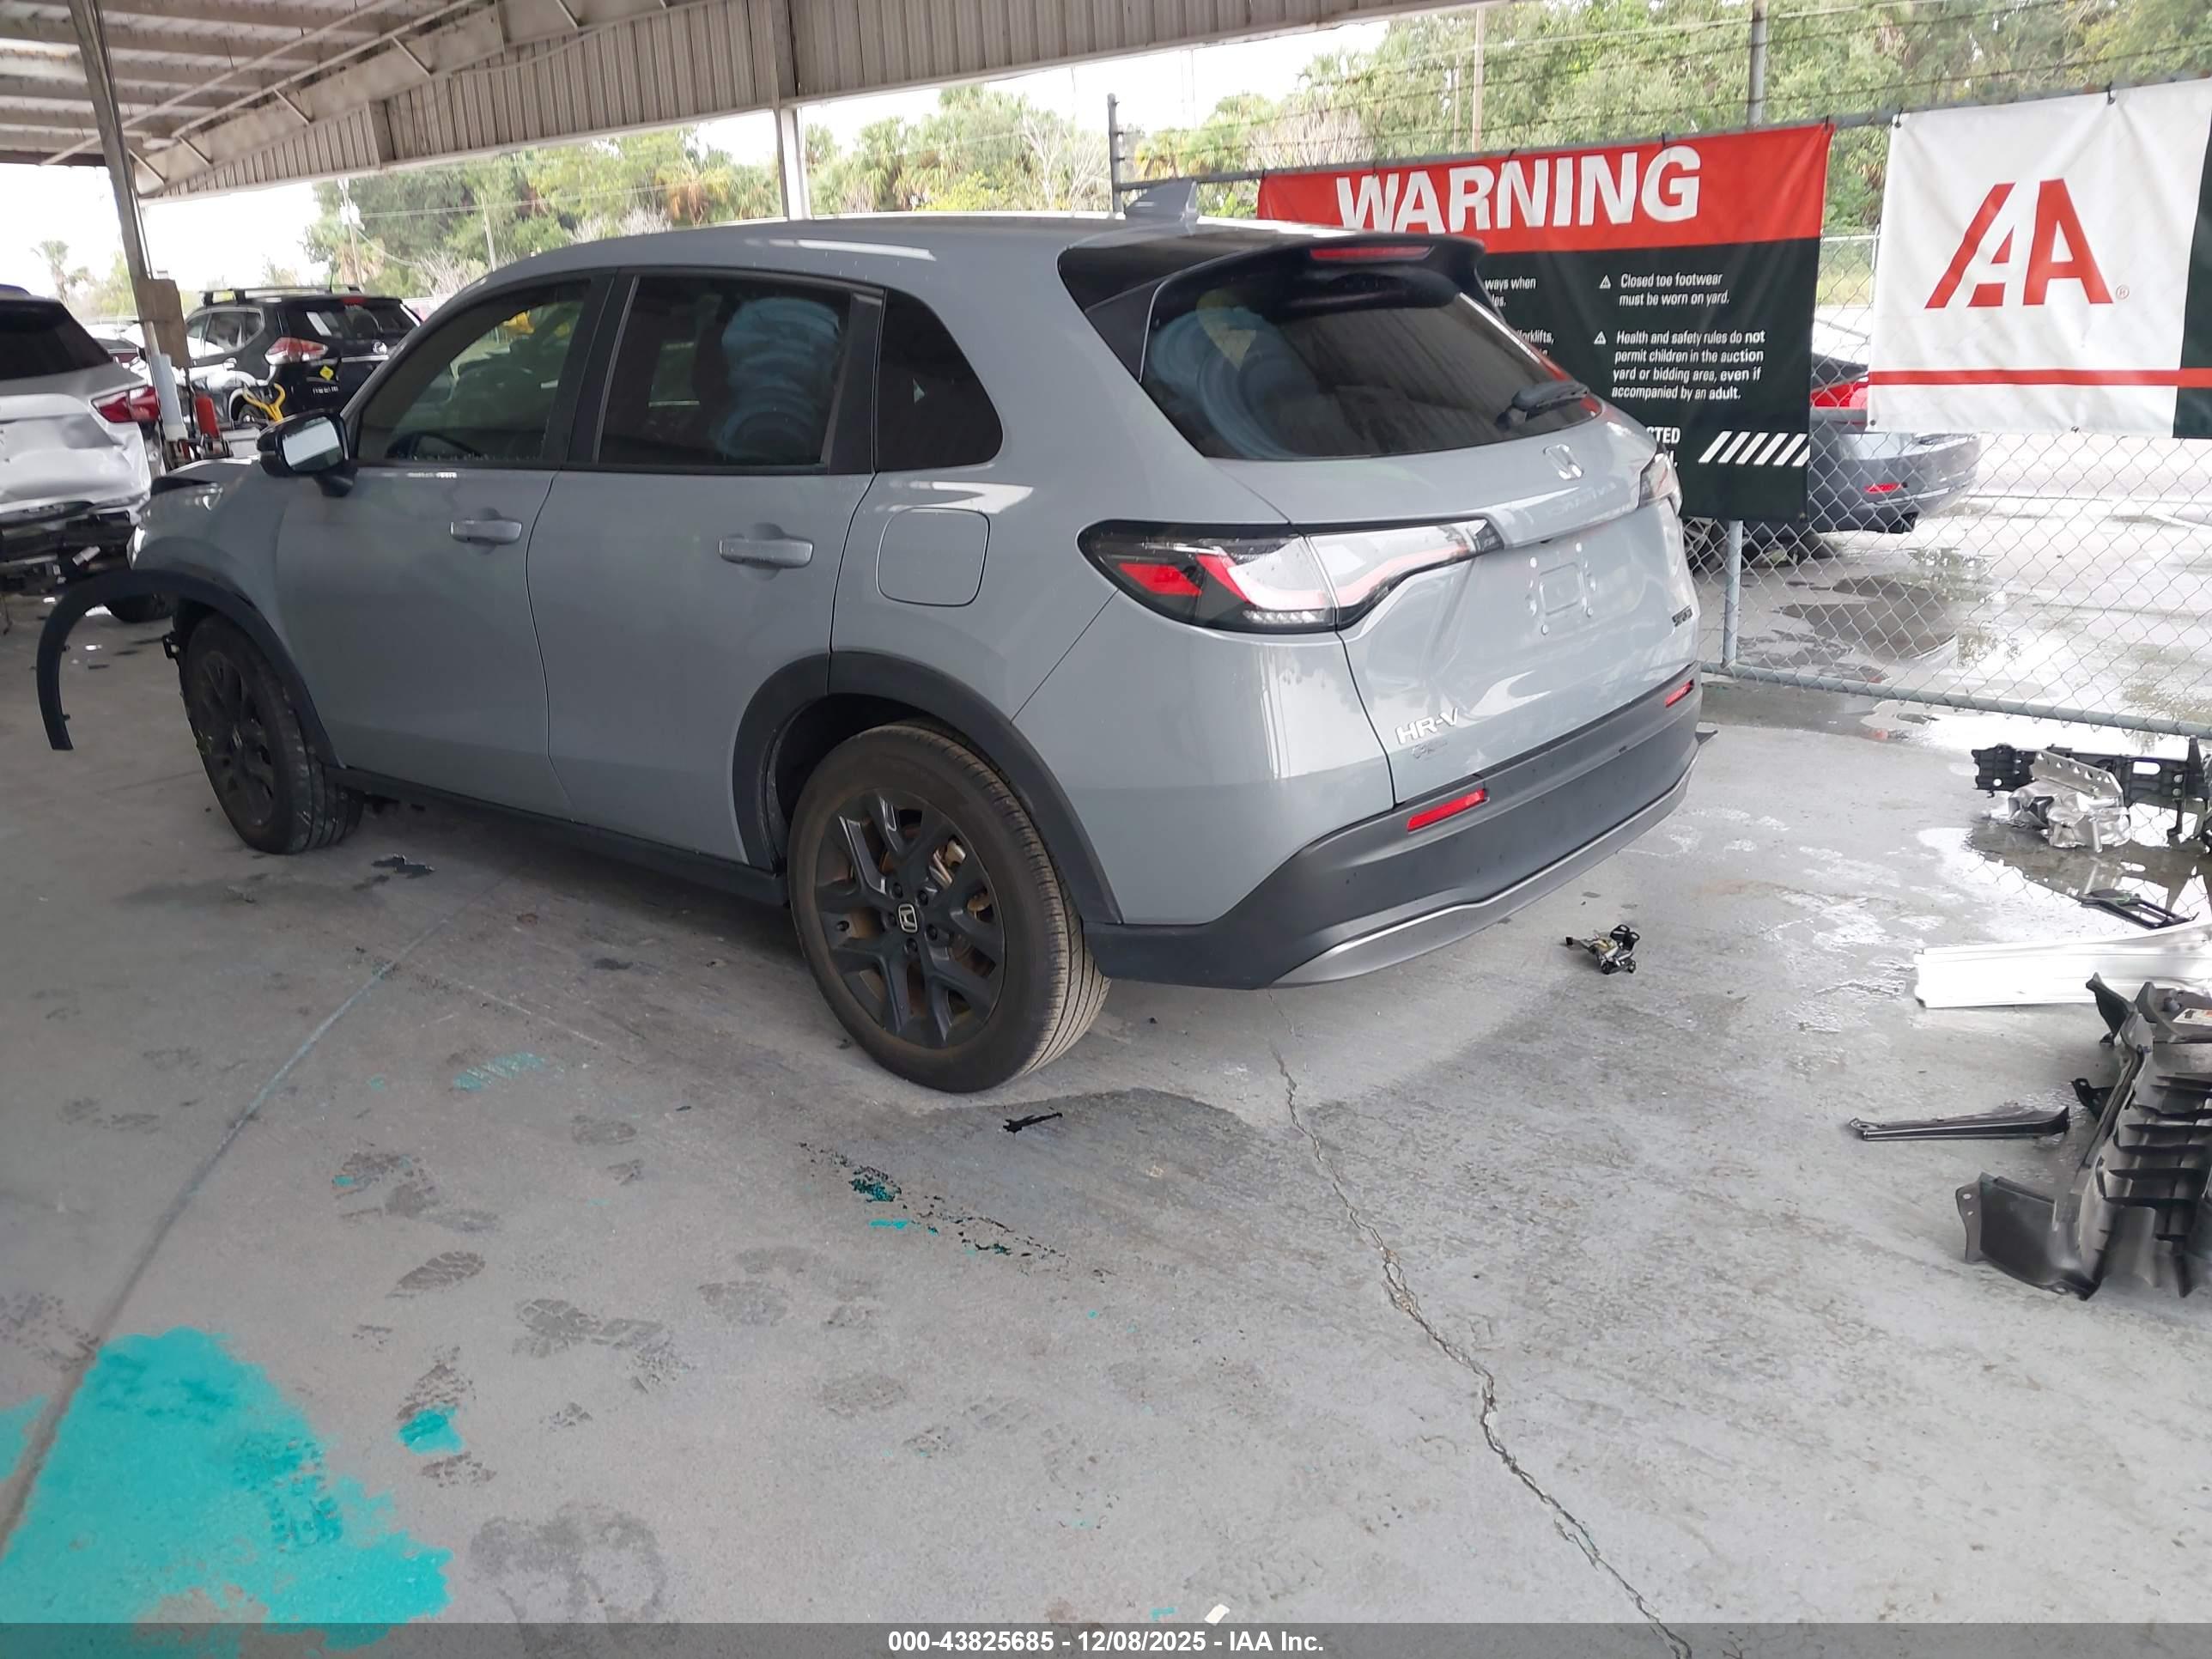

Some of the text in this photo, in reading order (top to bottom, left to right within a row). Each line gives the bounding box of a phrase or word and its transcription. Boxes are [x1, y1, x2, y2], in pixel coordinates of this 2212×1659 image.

[1336, 145, 1701, 234] WARNING
[1511, 276, 1536, 289] when
[1620, 272, 1723, 289] Closed toe footwear
[1620, 289, 1729, 307] must be worn on yard.
[1617, 331, 1765, 347] Health and safety rules do not
[1614, 349, 1764, 364] permit children in the auction
[1613, 367, 1761, 383] yard or bidding area, even if
[1612, 386, 1741, 402] accompanied by an adult.
[1395, 707, 1457, 744] HR-V
